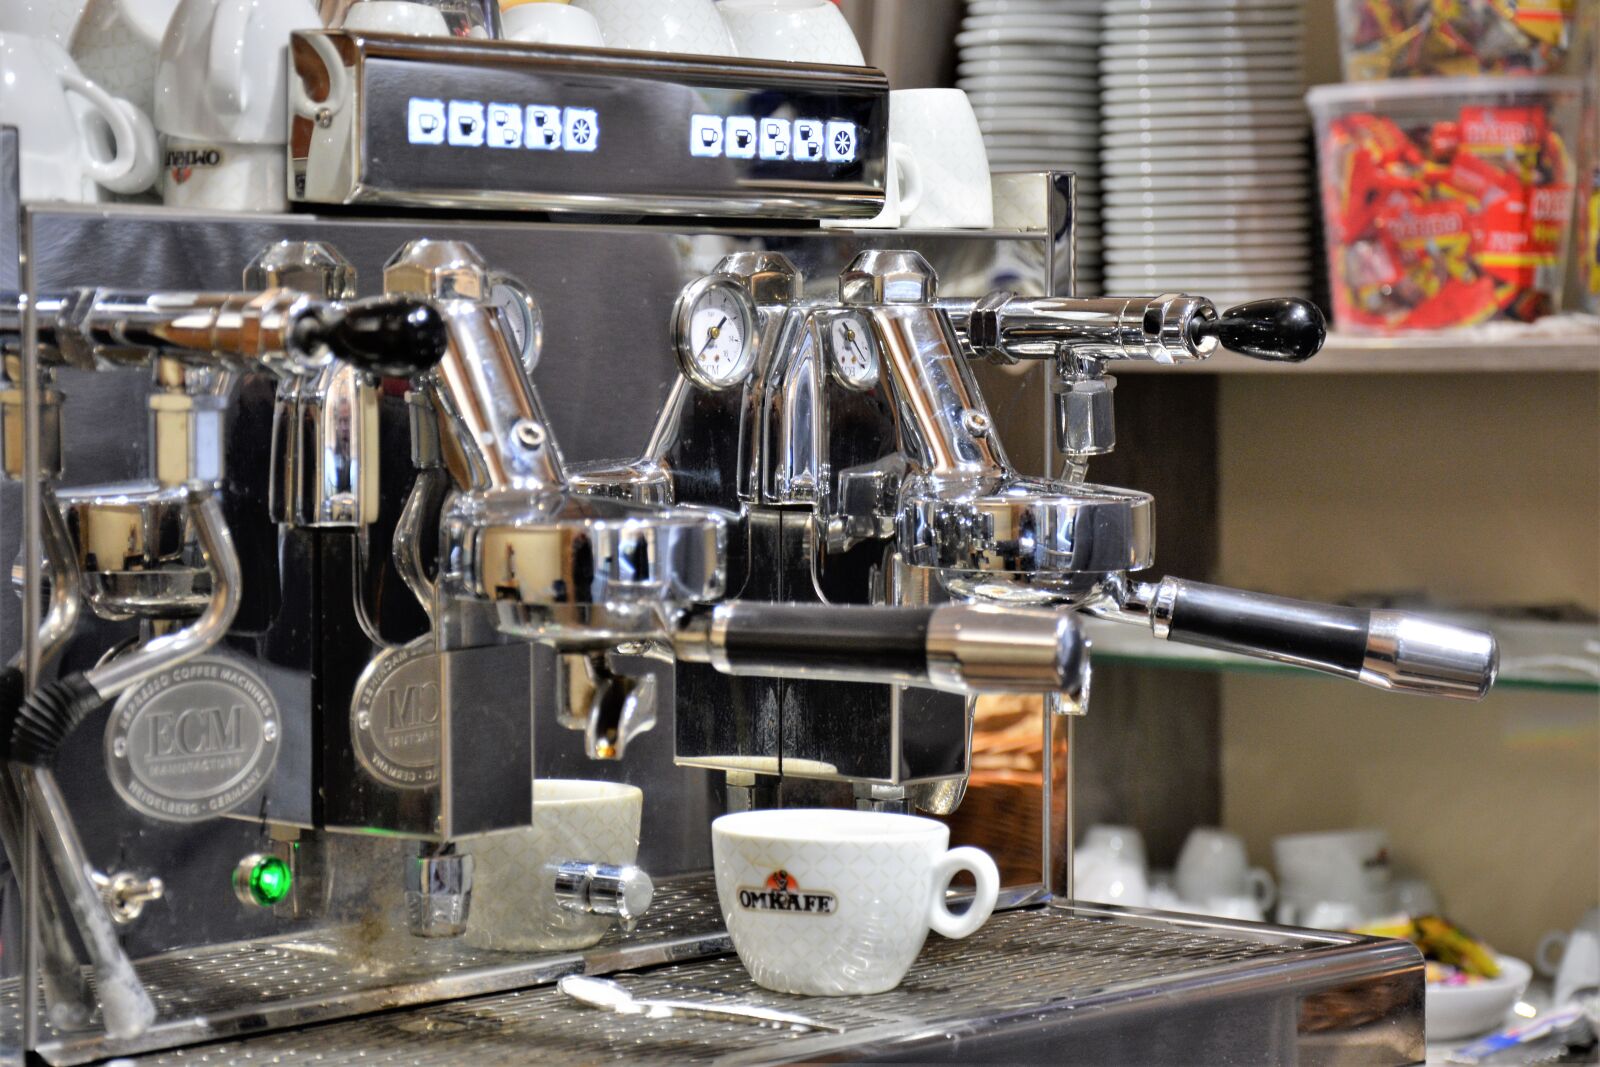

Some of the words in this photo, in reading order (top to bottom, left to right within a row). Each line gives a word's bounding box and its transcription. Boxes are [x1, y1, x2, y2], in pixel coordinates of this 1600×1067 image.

[172, 665, 218, 682] COFFEE
[219, 666, 273, 717] MACHINES
[144, 704, 246, 757] ECM
[150, 755, 242, 777] MANUFACTURE
[128, 780, 199, 816] HEIDELBERG
[208, 768, 262, 811] GERMANY
